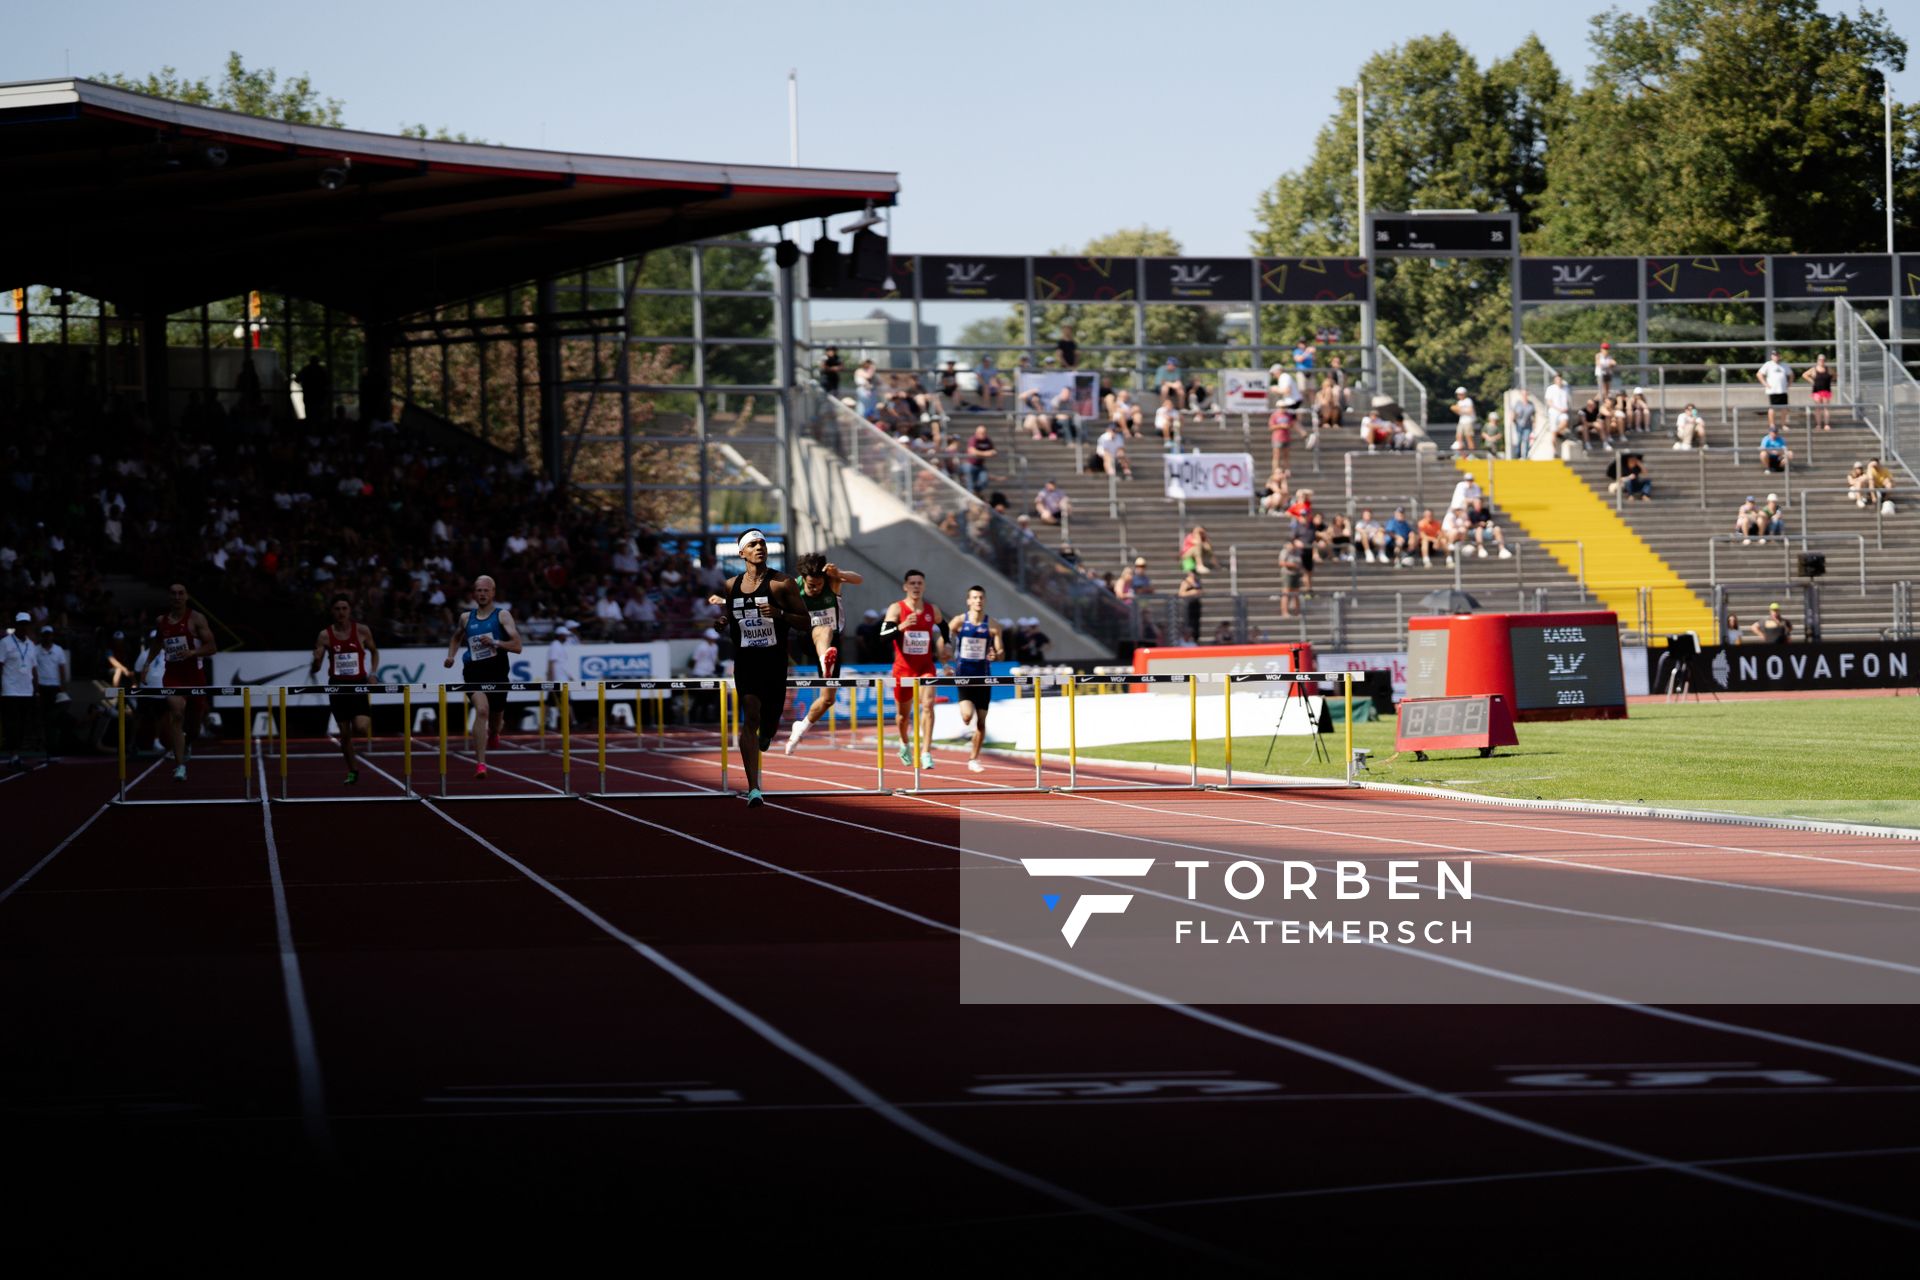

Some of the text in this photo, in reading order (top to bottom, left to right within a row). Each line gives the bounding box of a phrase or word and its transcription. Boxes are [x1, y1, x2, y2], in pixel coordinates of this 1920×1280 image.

[743, 628, 773, 639] ABUAKU
[1543, 627, 1586, 643] KASSEL
[608, 657, 649, 670] PLAN
[1739, 652, 1908, 681] NOVAFON
[1556, 690, 1585, 704] 2023
